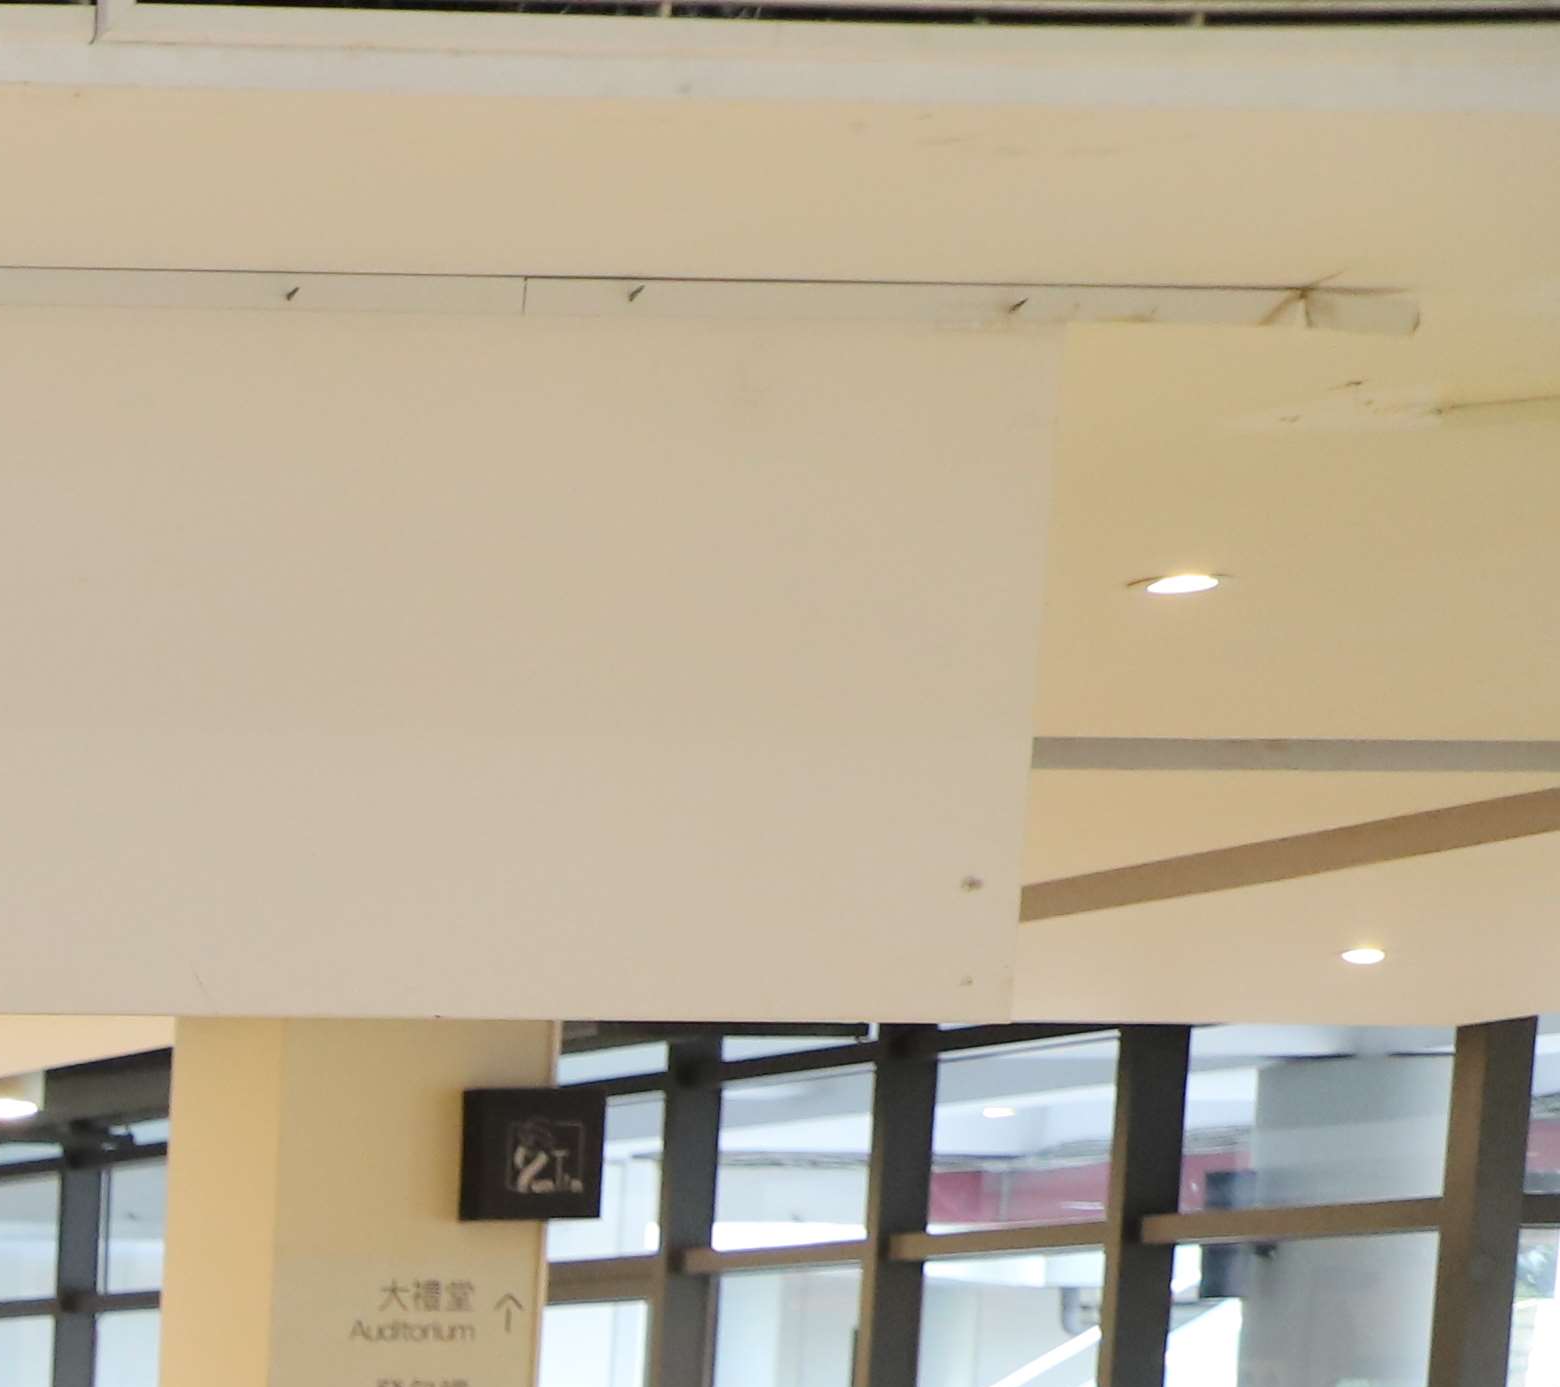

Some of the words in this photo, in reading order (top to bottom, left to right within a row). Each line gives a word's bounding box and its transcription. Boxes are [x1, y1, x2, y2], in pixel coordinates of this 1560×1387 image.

[378, 1279, 476, 1312] 大禮堂
[349, 1320, 476, 1341] Auditorium
